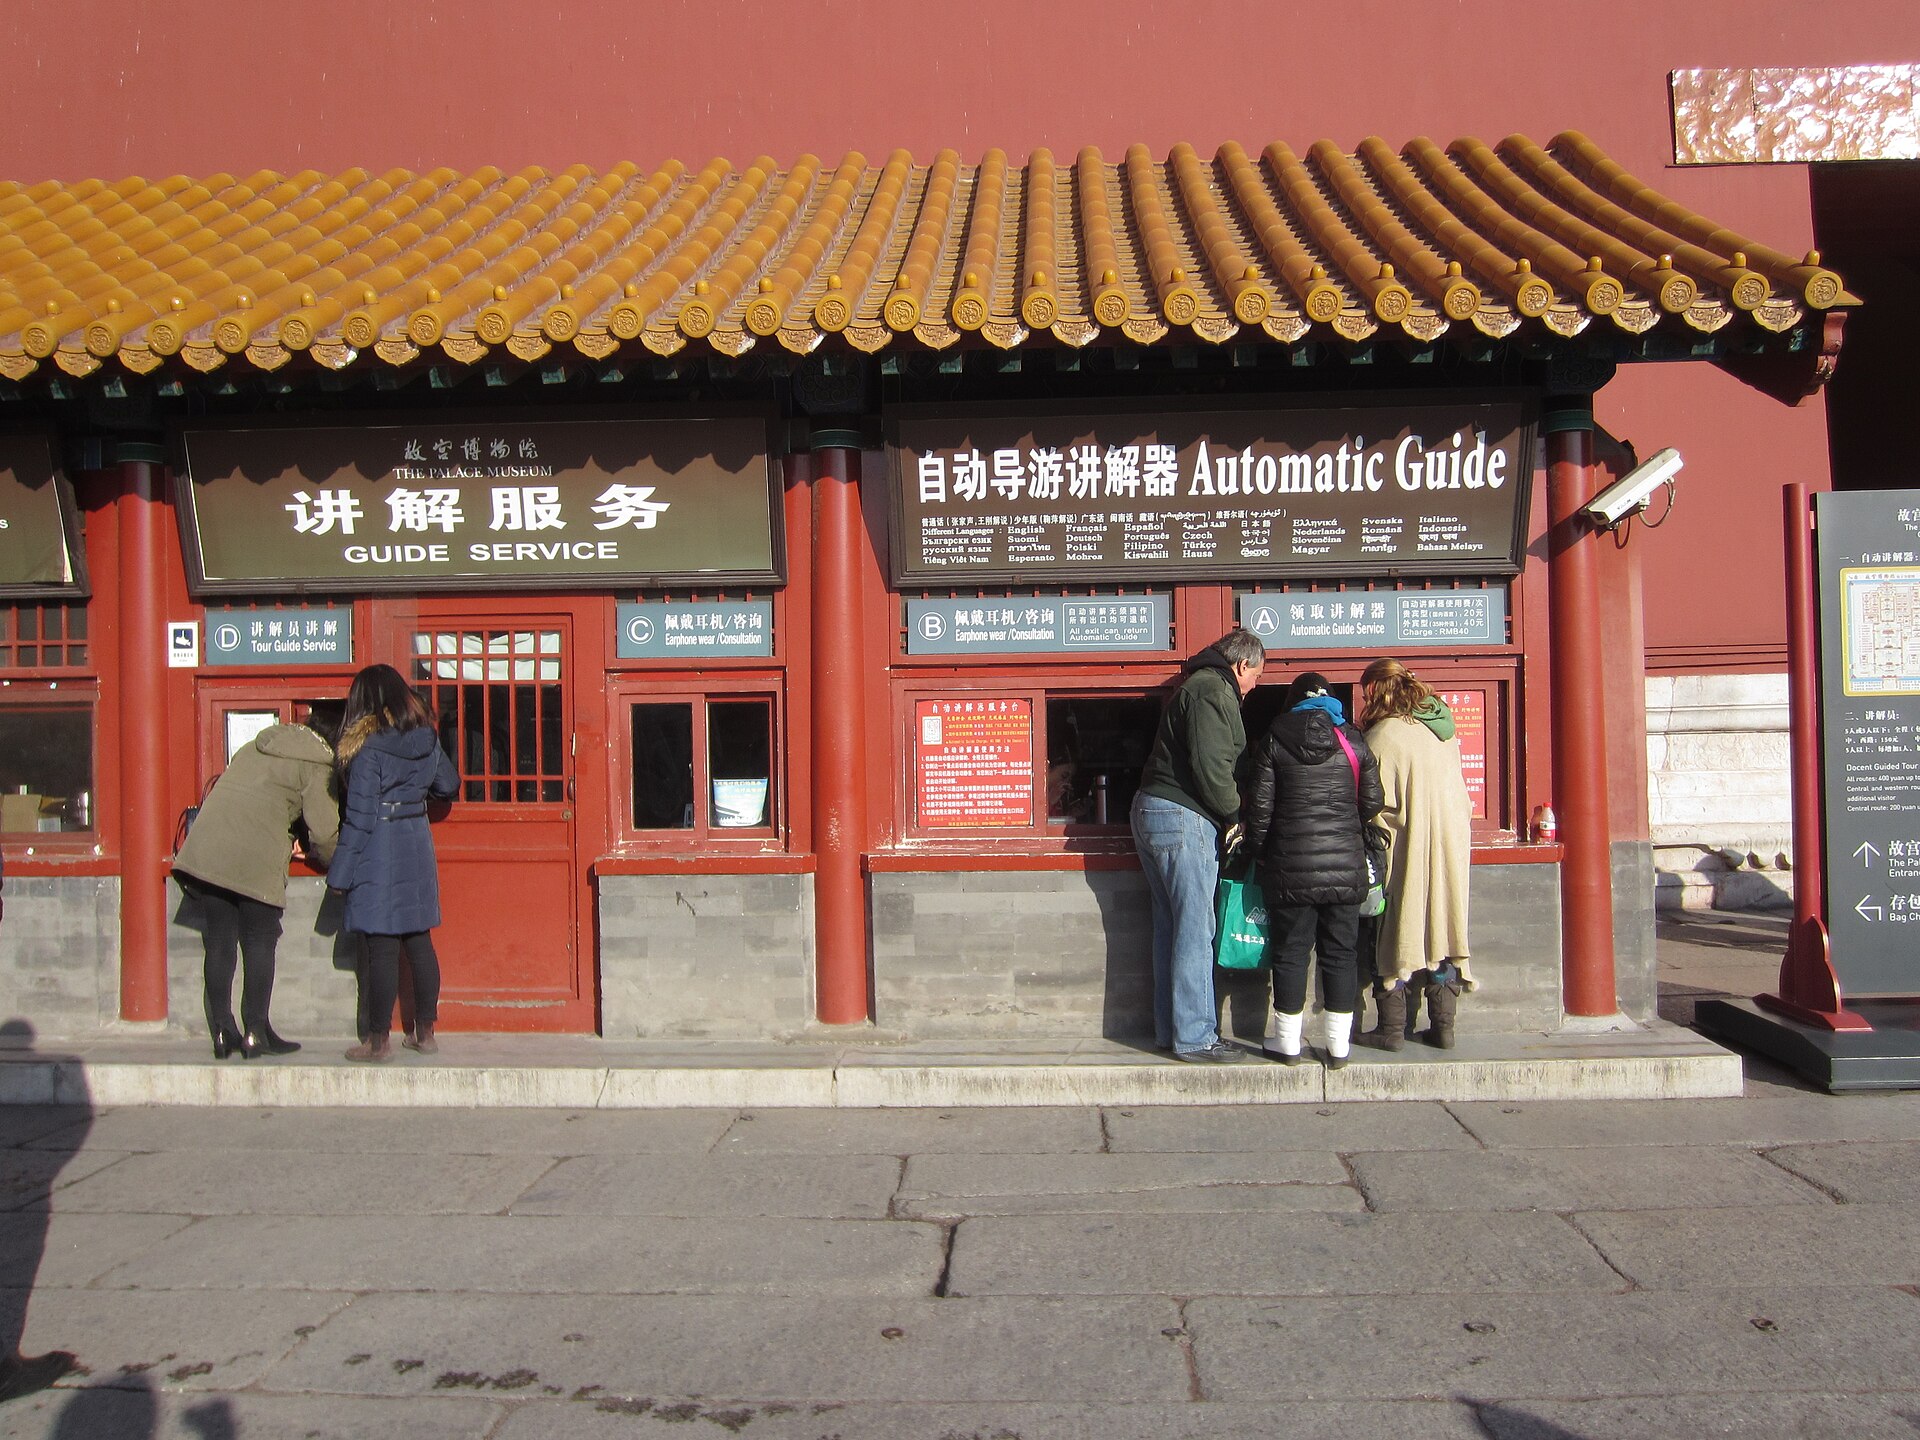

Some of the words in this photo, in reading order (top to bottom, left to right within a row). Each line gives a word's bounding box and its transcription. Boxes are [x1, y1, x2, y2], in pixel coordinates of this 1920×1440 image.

[404, 437, 539, 462] 故宫博物院
[918, 443, 1180, 503] 自动导游讲解器
[1188, 436, 1384, 498] Automatic
[1398, 431, 1507, 492] Guide
[392, 468, 425, 480] THE
[429, 467, 484, 479] PALACE
[487, 465, 553, 478] MUSEUM
[284, 483, 671, 535] 讲解服务
[1293, 518, 1338, 528] Ελληνικά
[1361, 517, 1403, 525] Svenska
[921, 528, 955, 536] Different
[956, 527, 994, 536] Languages
[1007, 526, 1045, 535] English
[1066, 524, 1108, 533] Français
[1124, 522, 1164, 532] Español
[1292, 527, 1346, 536] Nederlands
[1418, 524, 1467, 532] Indonesia
[1904, 523, 1918, 531] The
[1007, 535, 1039, 543] Suomi
[1066, 534, 1103, 542] Deutsch
[1124, 532, 1170, 541] Português
[1182, 531, 1213, 540] Czech
[1291, 536, 1342, 544] Slovenčina
[922, 537, 969, 546] Български
[1182, 541, 1217, 550] Türkçe
[922, 546, 964, 555] русский
[1066, 543, 1097, 551] Polski
[1124, 542, 1163, 551] Filipino
[1291, 545, 1330, 555] Magyar
[1417, 543, 1448, 551] Bahasa
[1450, 542, 1483, 551] Melayu
[343, 544, 450, 563] GUIDE
[469, 542, 619, 562] SERVICE
[1124, 550, 1169, 560] Kiswahili
[1182, 550, 1213, 558] Hausa
[969, 555, 989, 563] Nam
[1008, 555, 1055, 564] Esperanto
[1290, 602, 1386, 621] 领取讲解器
[664, 612, 762, 631] 佩戴耳机/咨询
[954, 608, 1055, 627] 佩戴耳机/咨询
[1255, 609, 1275, 630] A
[251, 620, 338, 637] 讲解员讲解
[630, 619, 649, 641] C
[925, 616, 942, 636] B
[1290, 622, 1330, 636] Automatic
[1332, 622, 1355, 635] Guide
[1356, 621, 1385, 635] Service
[1069, 627, 1080, 635] All
[1085, 627, 1100, 635] exit
[1402, 628, 1433, 637] Charge
[221, 627, 238, 648] D
[665, 632, 698, 648] Earphone
[698, 635, 716, 645] wear
[955, 629, 989, 644] Earphone
[989, 630, 1007, 641] wear
[251, 640, 273, 653] Tour
[274, 639, 301, 652] Guide
[302, 639, 337, 652] Service
[1846, 763, 1873, 771] Docent
[1873, 762, 1900, 771] Guided
[1901, 762, 1919, 770] Tour
[1901, 804, 1916, 812] yuan
[1888, 840, 1920, 856] 故宫
[1888, 858, 1905, 867] The
[1889, 893, 1920, 911] 存包
[1889, 912, 1907, 923] Bag
[1909, 912, 1920, 921] Ch
